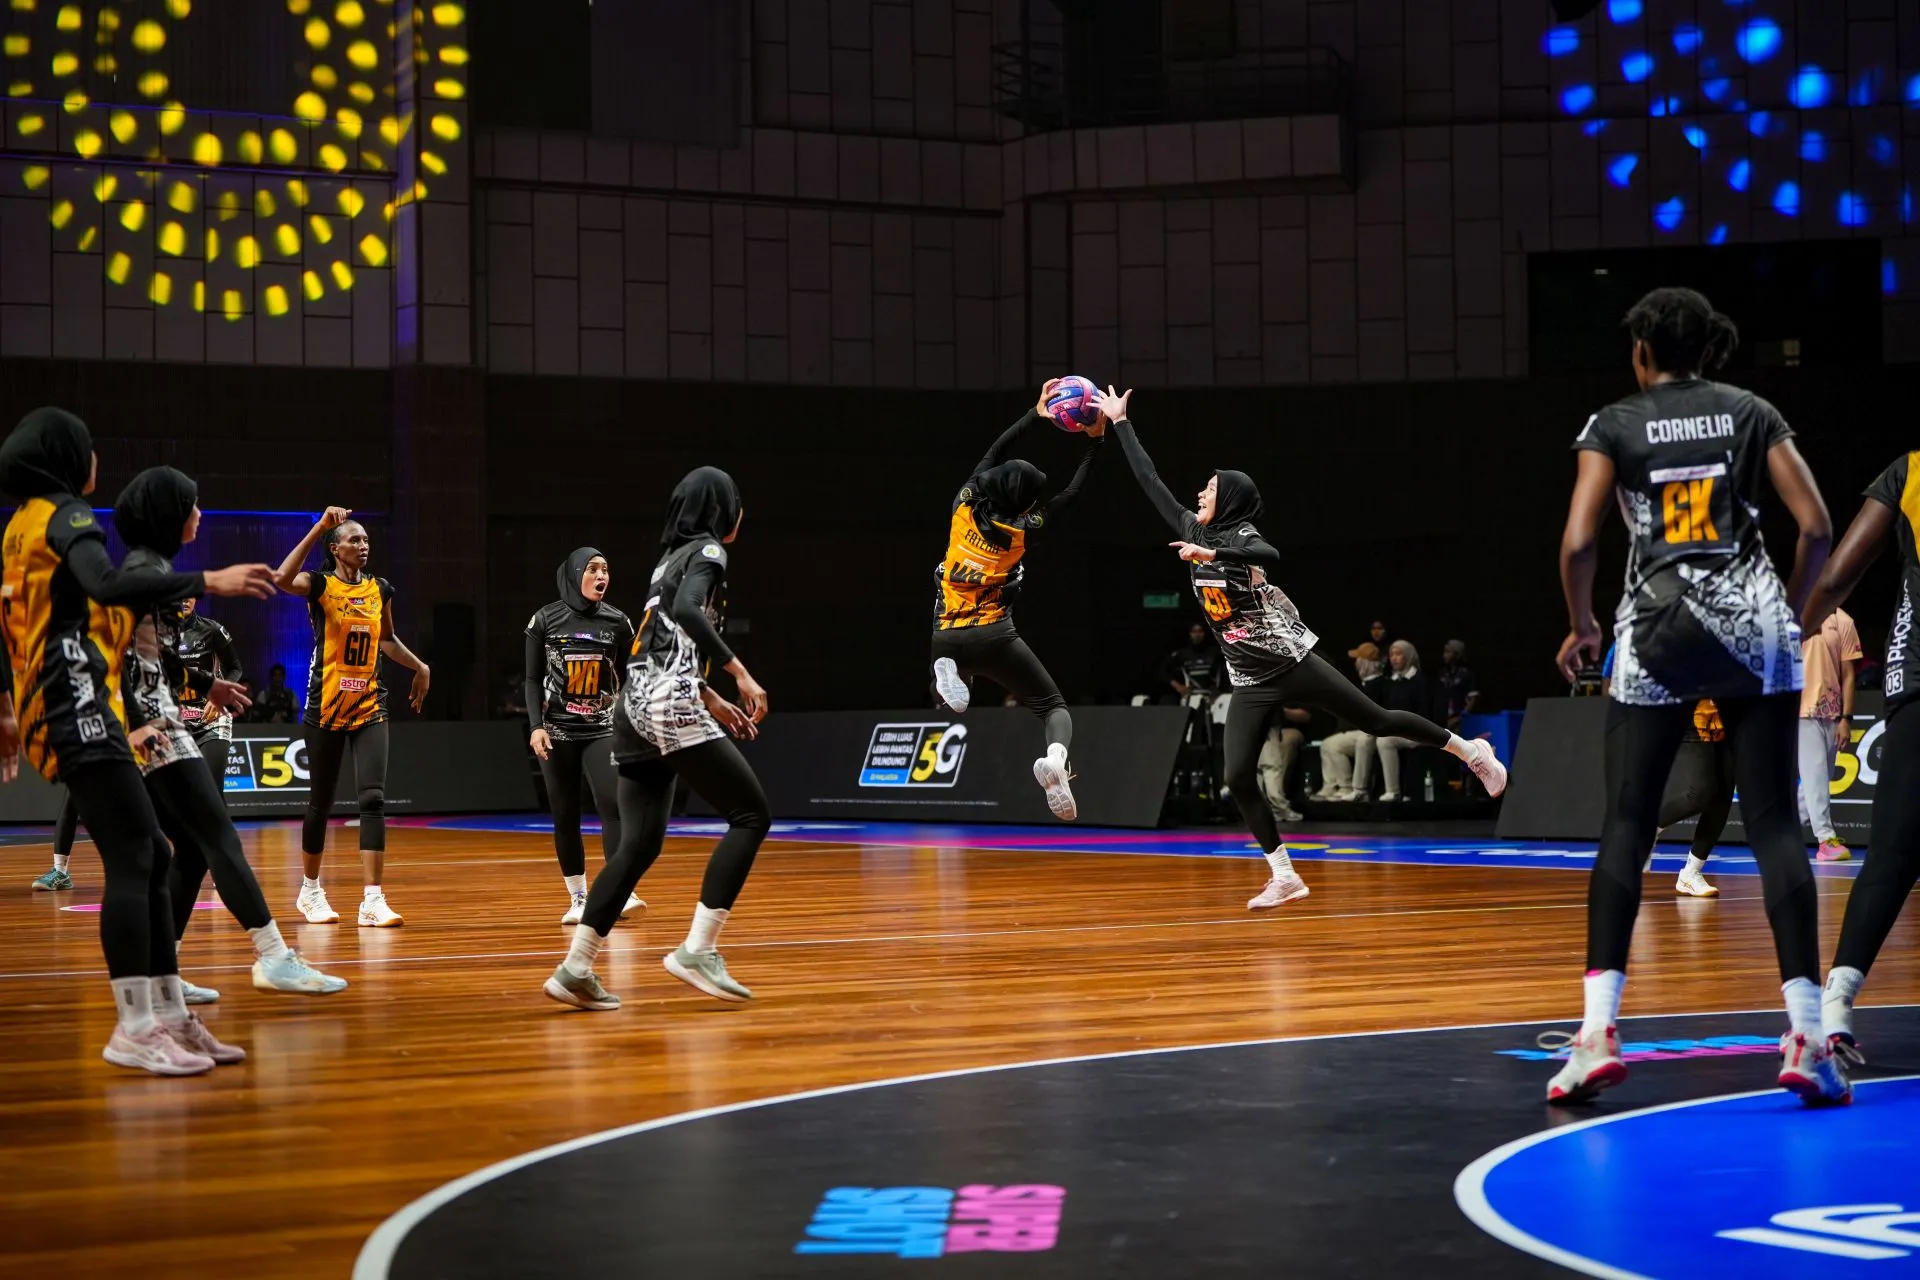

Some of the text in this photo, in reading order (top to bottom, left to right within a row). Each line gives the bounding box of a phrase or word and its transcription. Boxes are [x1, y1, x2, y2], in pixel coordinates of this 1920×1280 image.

[1646, 413, 1734, 444] CORNELIA
[1663, 477, 1719, 544] GK
[1202, 587, 1233, 622] GD
[344, 631, 371, 667] GD
[341, 678, 366, 688] astro
[567, 661, 600, 695] WA
[1886, 673, 1902, 693] 03
[180, 708, 200, 719] stro
[567, 703, 593, 714] astro
[81, 717, 104, 739] 09
[227, 756, 245, 764] TAS
[911, 724, 968, 782] 5G
[793, 1185, 955, 1259] SHOT
[944, 1183, 1067, 1254] SUPER
